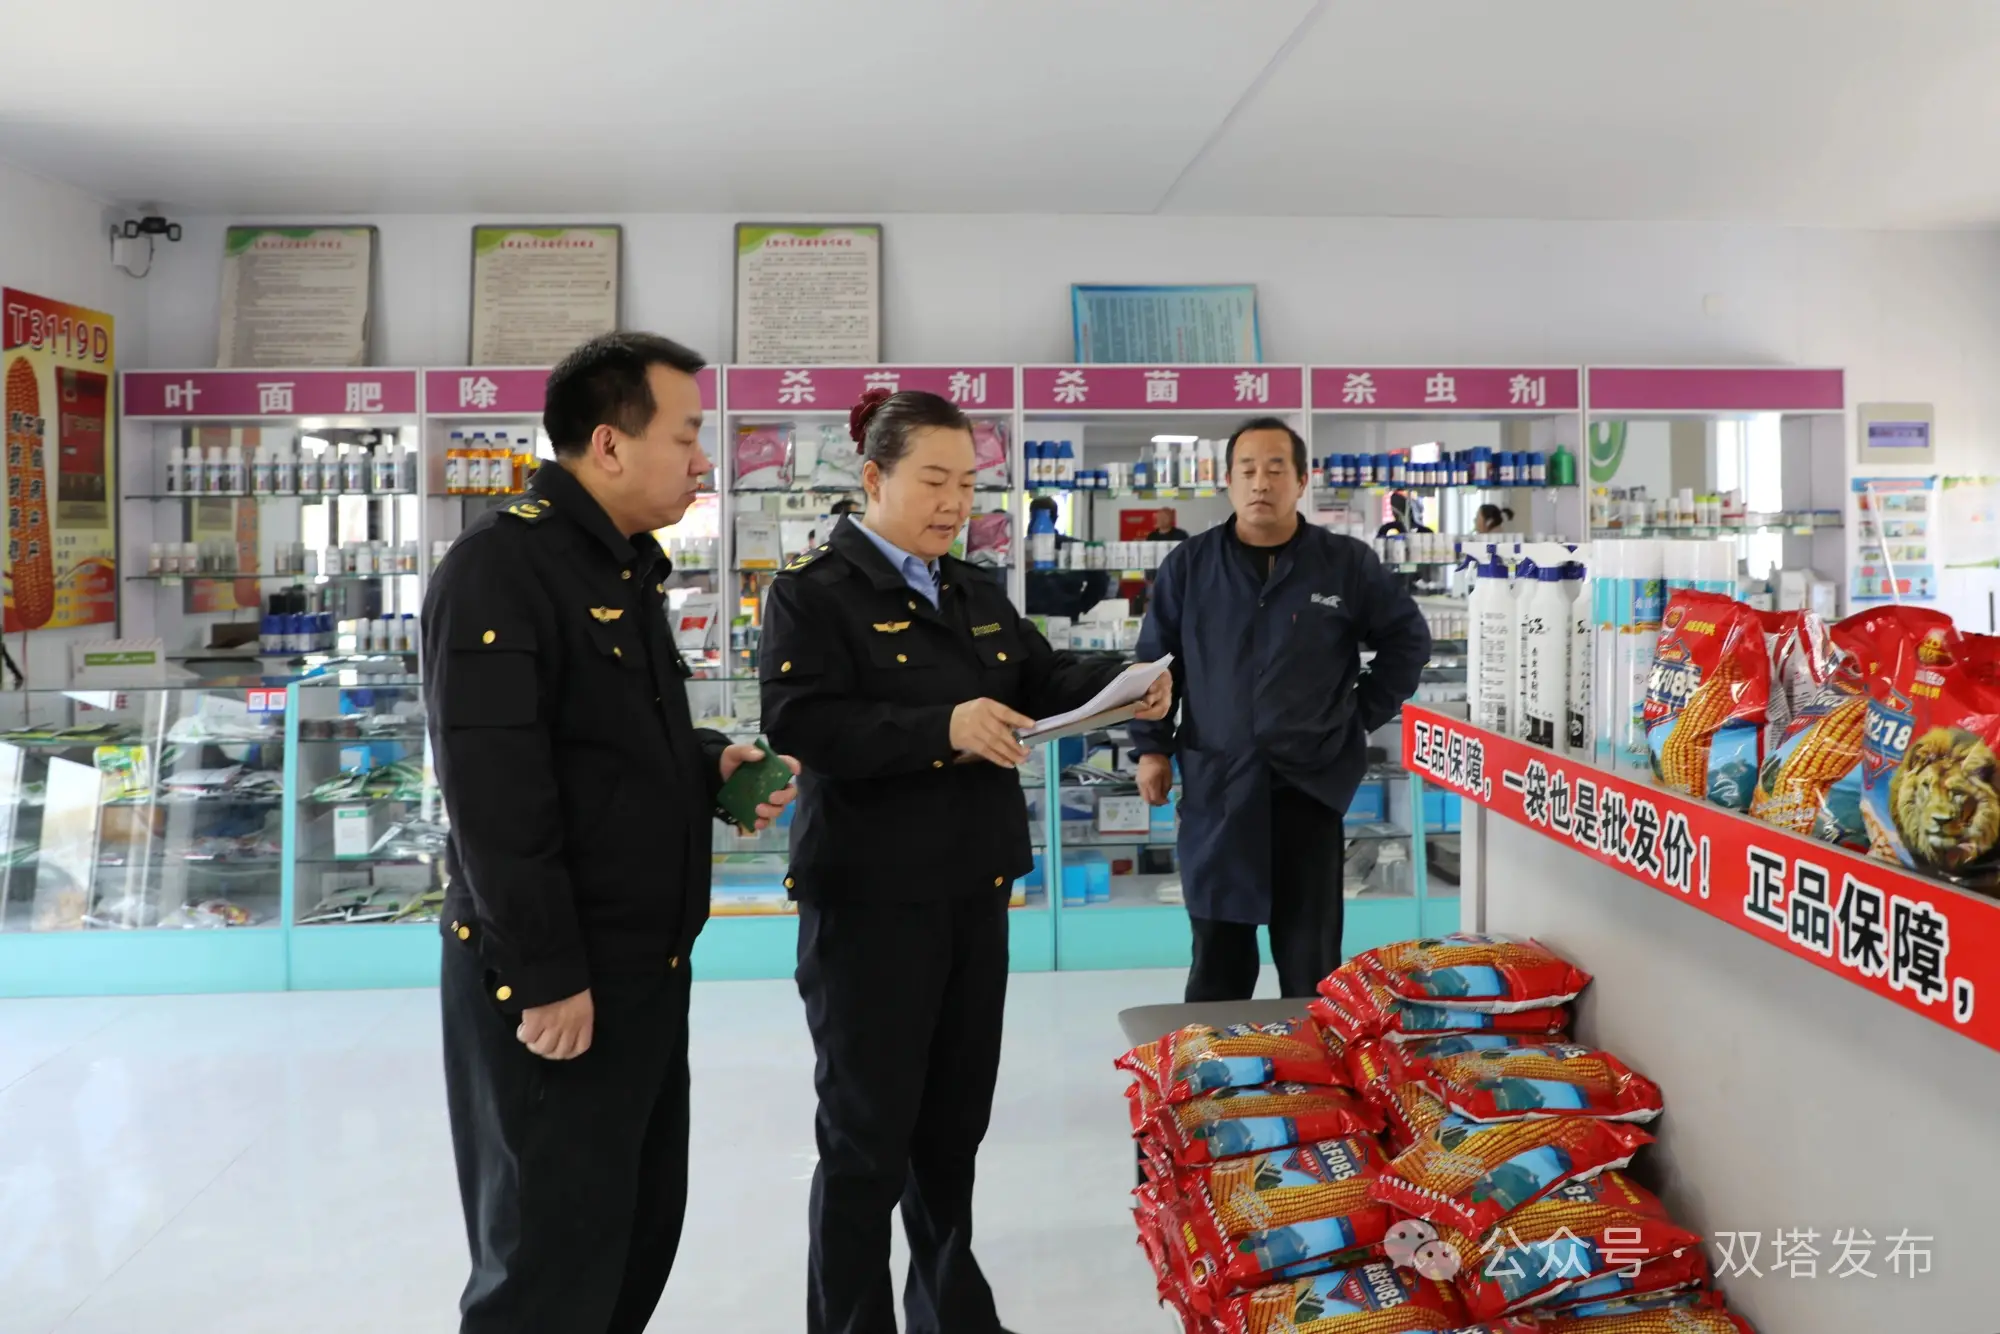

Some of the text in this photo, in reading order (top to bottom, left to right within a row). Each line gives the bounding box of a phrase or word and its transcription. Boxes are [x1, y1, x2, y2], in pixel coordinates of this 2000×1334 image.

[8, 303, 109, 362] T3119D
[165, 382, 384, 413] 叶面肥
[1053, 370, 1270, 404] 杀菌剂
[1342, 373, 1546, 406] 杀虫剂
[1744, 845, 1974, 1023] 正品保障，
